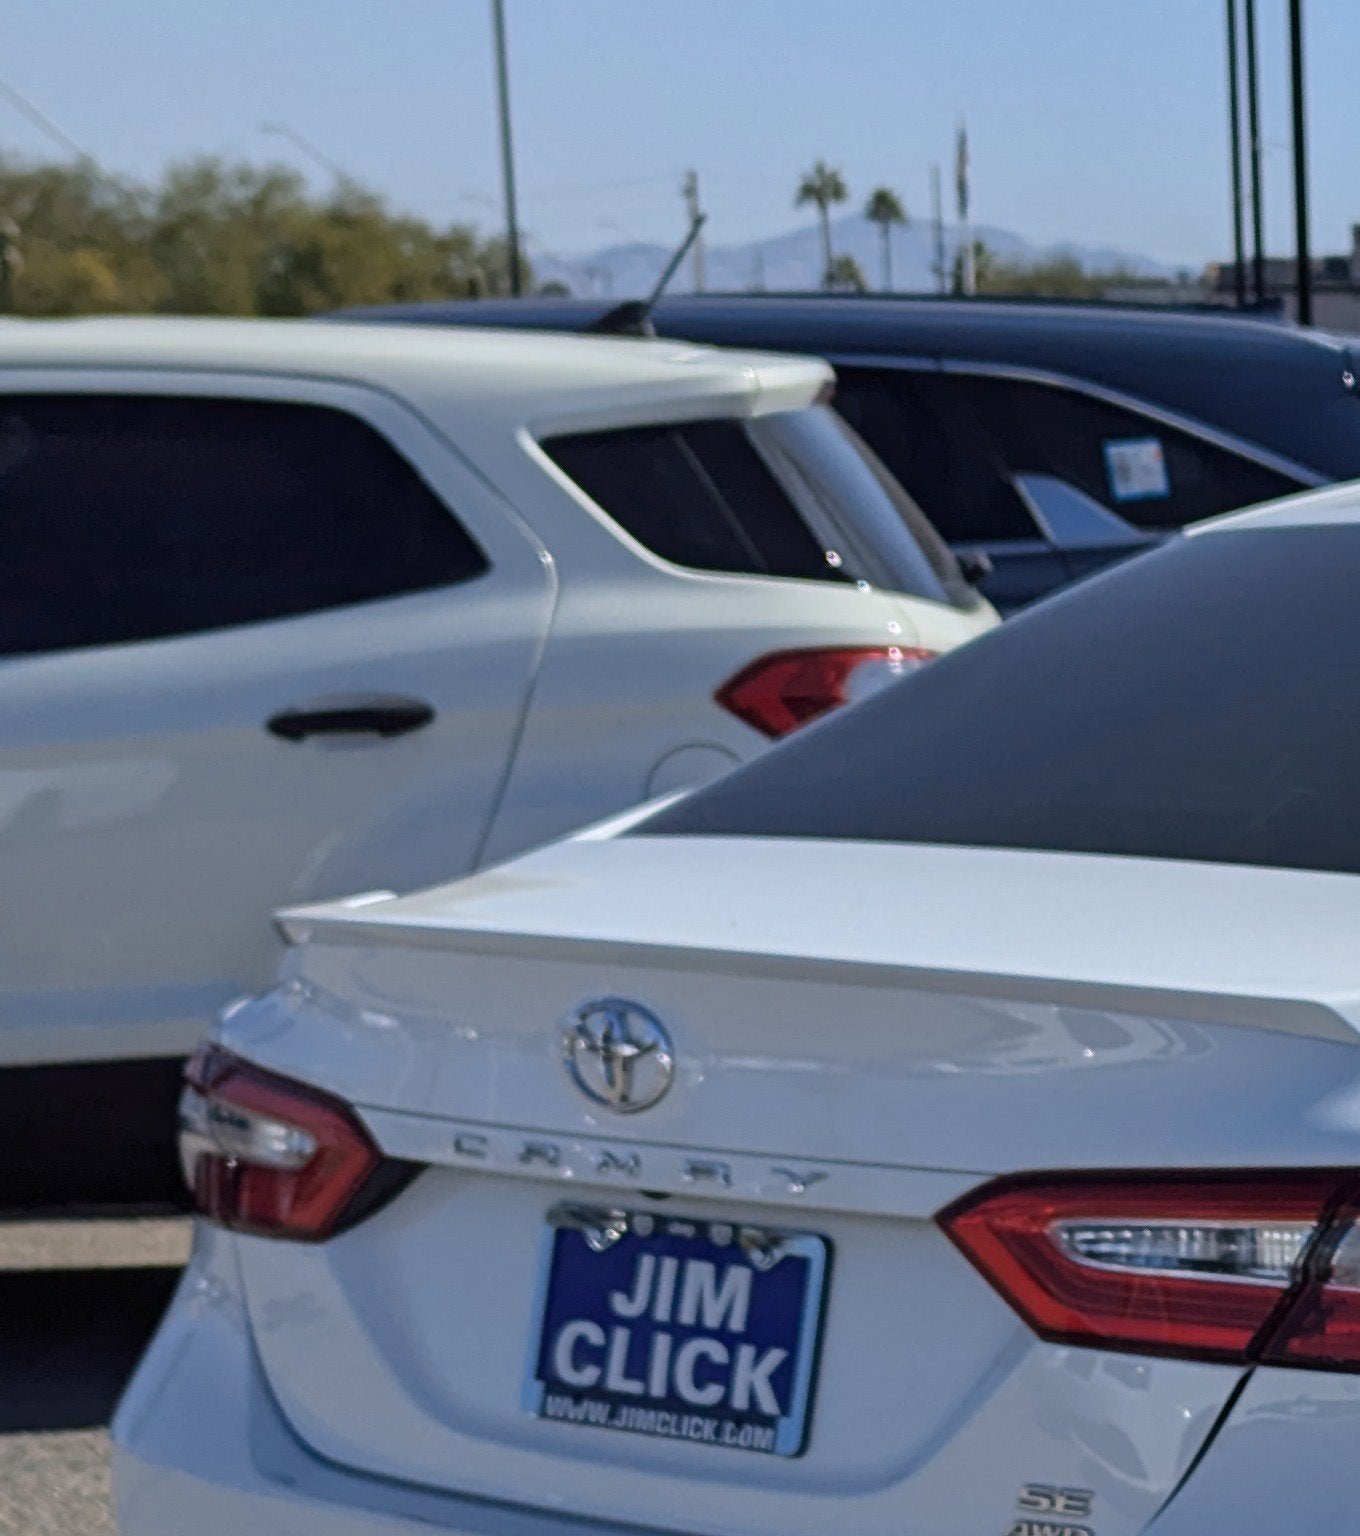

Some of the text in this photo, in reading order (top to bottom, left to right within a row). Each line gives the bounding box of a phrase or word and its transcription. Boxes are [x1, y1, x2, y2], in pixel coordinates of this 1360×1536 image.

[452, 1131, 830, 1194] CAMRY
[608, 1253, 753, 1333] JIM
[554, 1318, 790, 1417] CLICK
[545, 1395, 774, 1450] WWW.JIMCLICK.COM
[1017, 1482, 1096, 1517] SE
